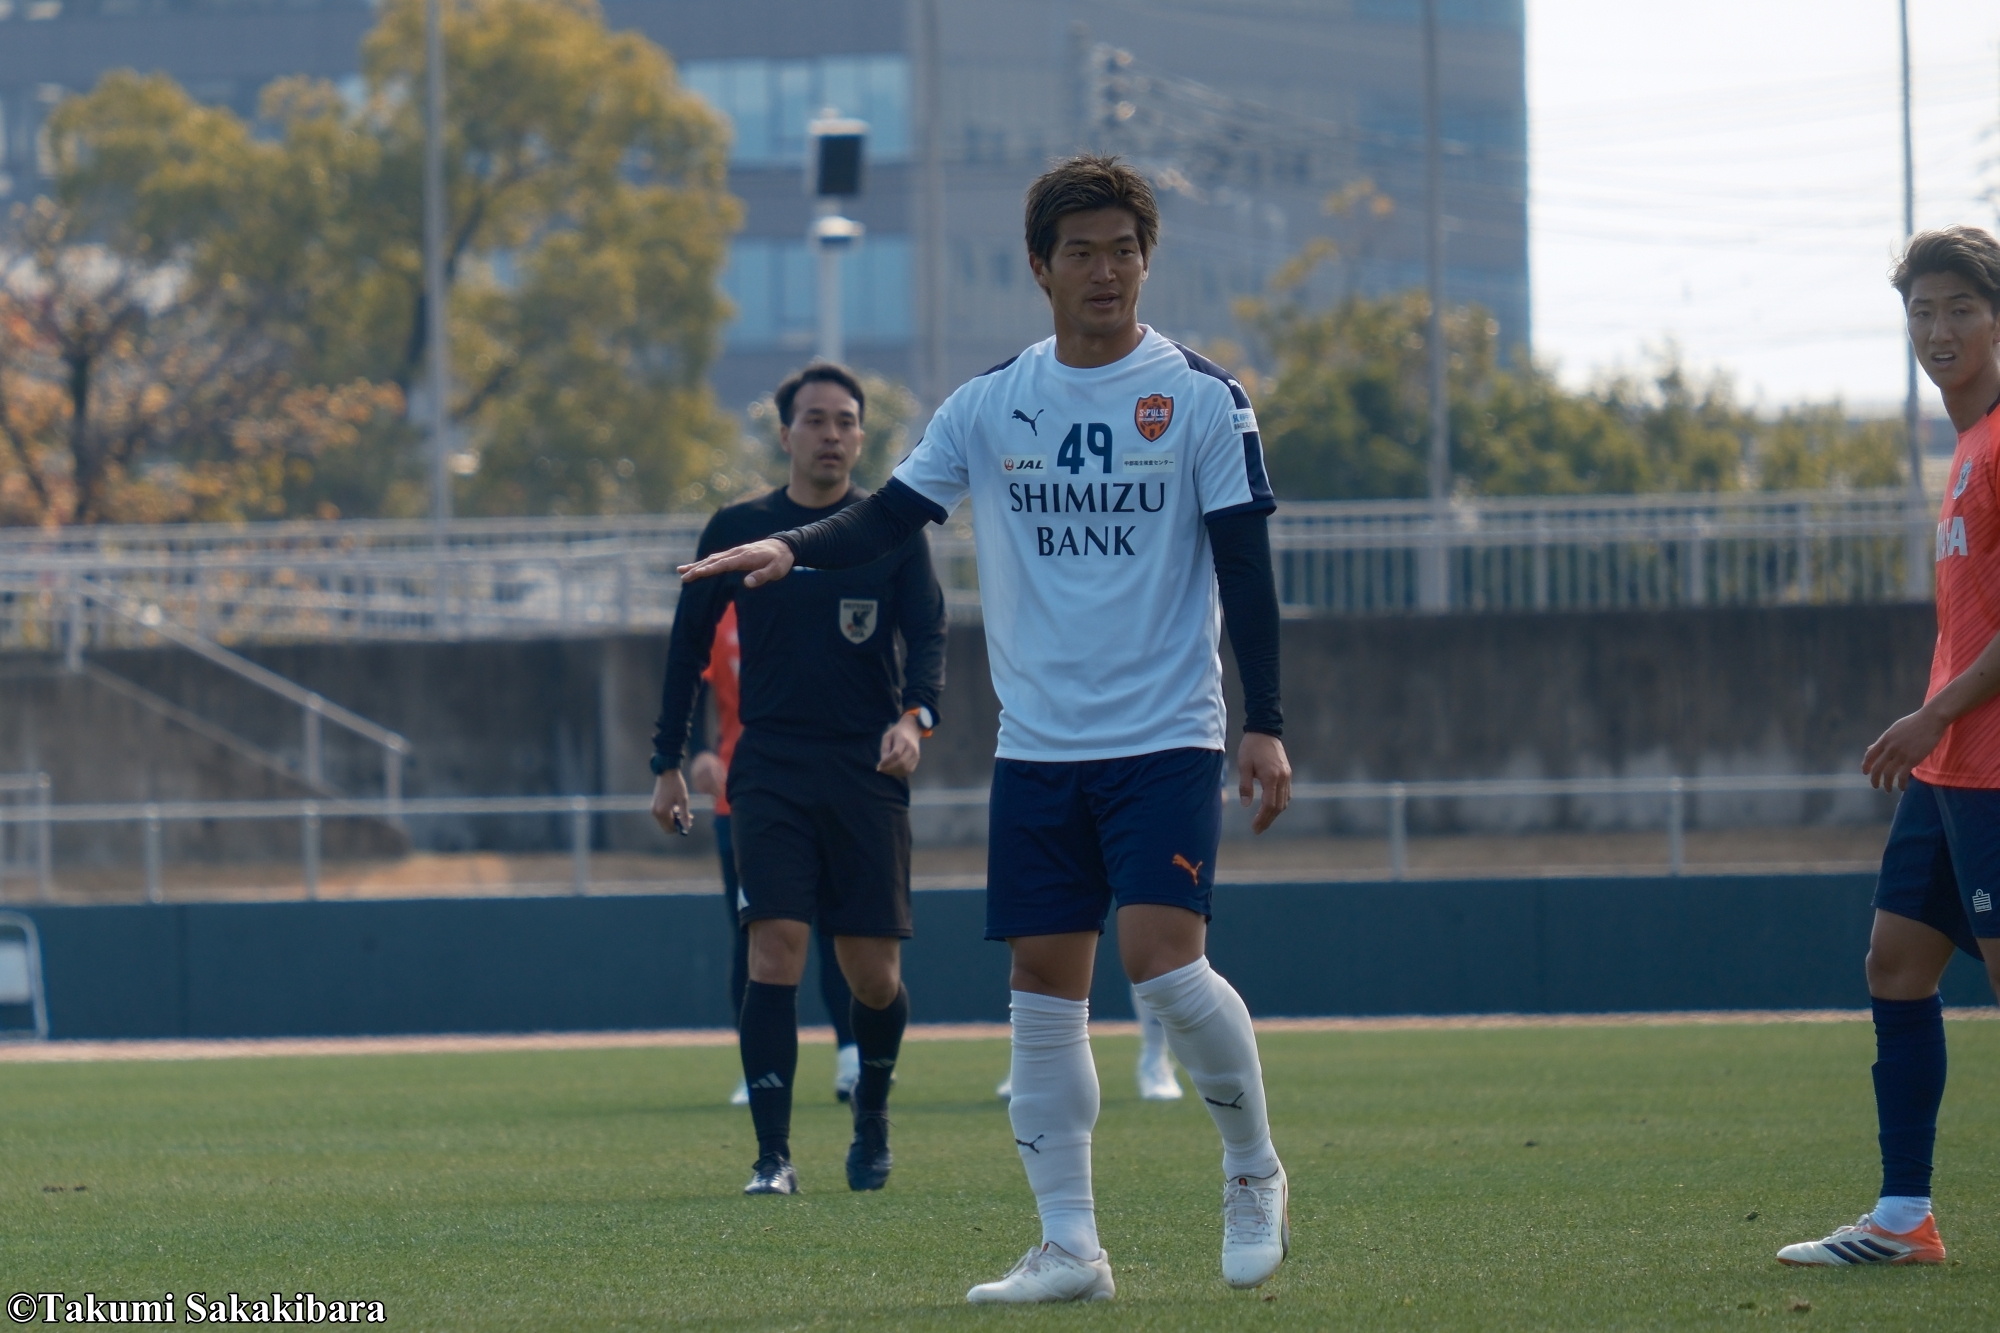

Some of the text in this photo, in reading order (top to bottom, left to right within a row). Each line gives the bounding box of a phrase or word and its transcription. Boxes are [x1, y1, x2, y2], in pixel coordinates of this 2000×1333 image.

[1056, 422, 1113, 475] 49
[1016, 459, 1044, 470] JAL
[1009, 482, 1165, 513] SHIMIZU
[1036, 525, 1136, 557] BANK
